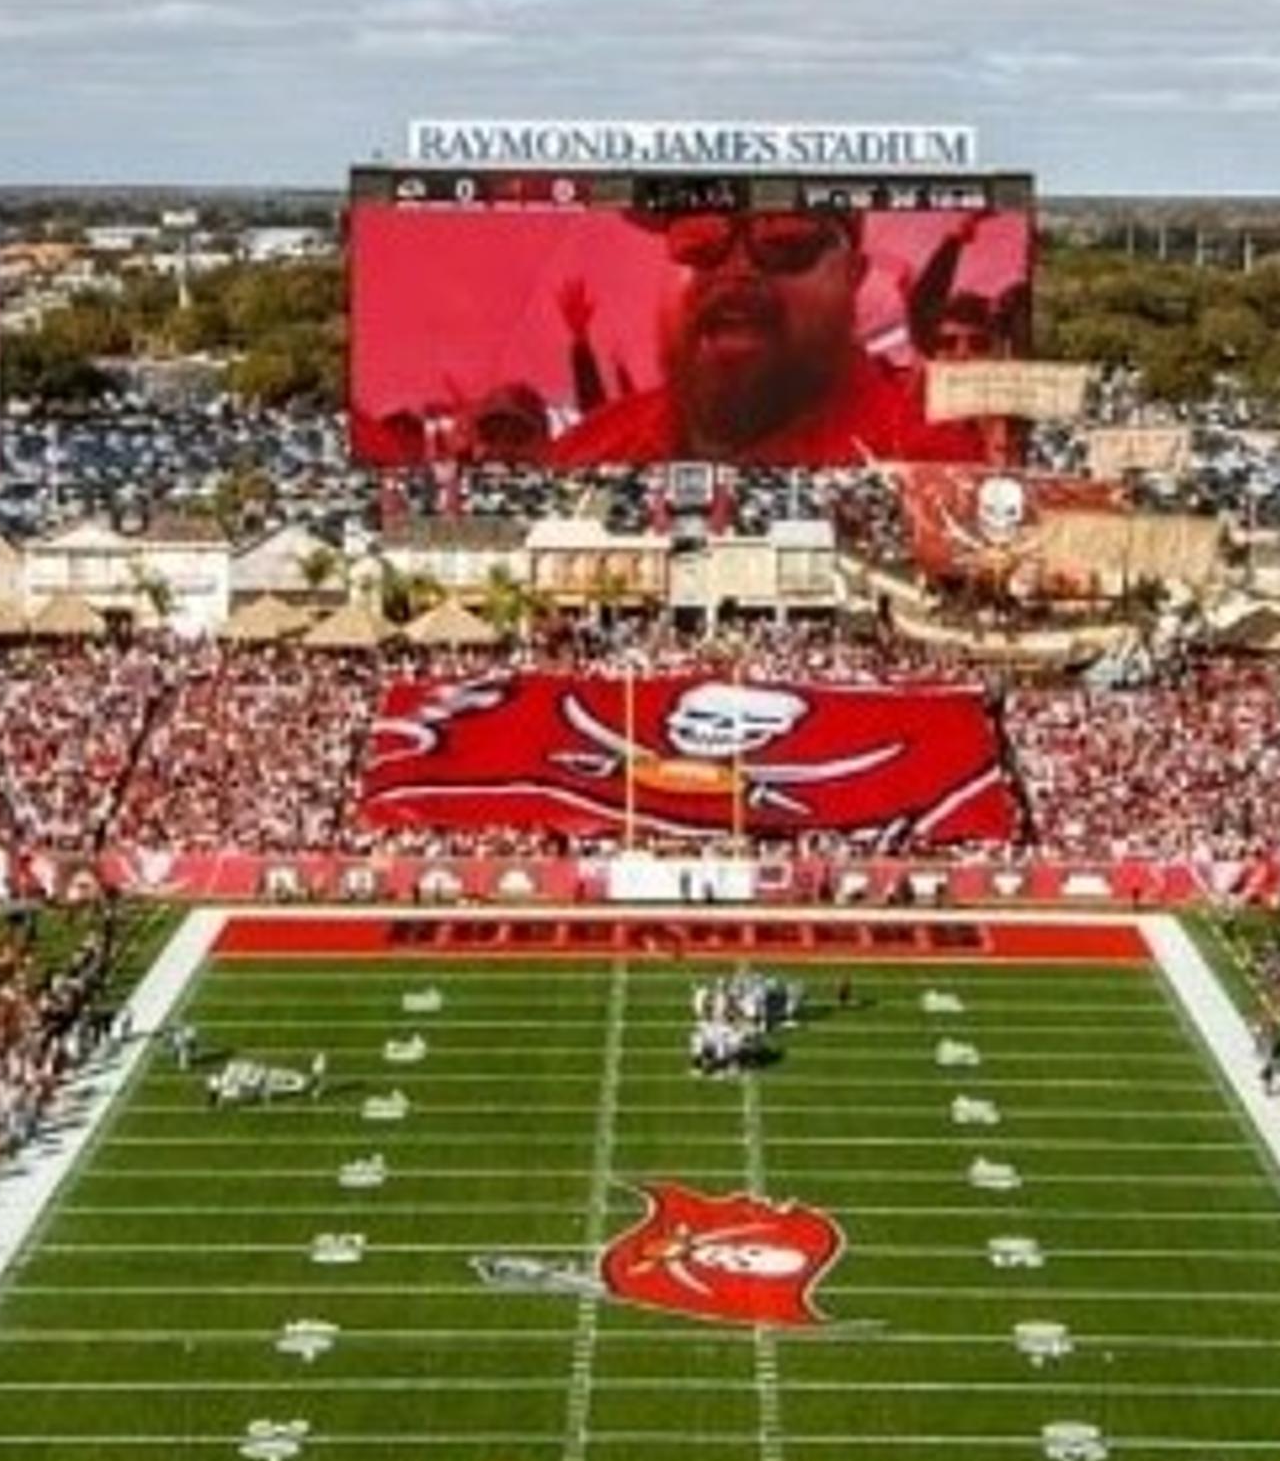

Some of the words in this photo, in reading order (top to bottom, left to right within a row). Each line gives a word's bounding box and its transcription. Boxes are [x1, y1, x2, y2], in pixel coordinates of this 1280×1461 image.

[418, 125, 634, 161] RAYMOND
[638, 127, 779, 164] JAMES
[785, 129, 970, 166] STADIUM
